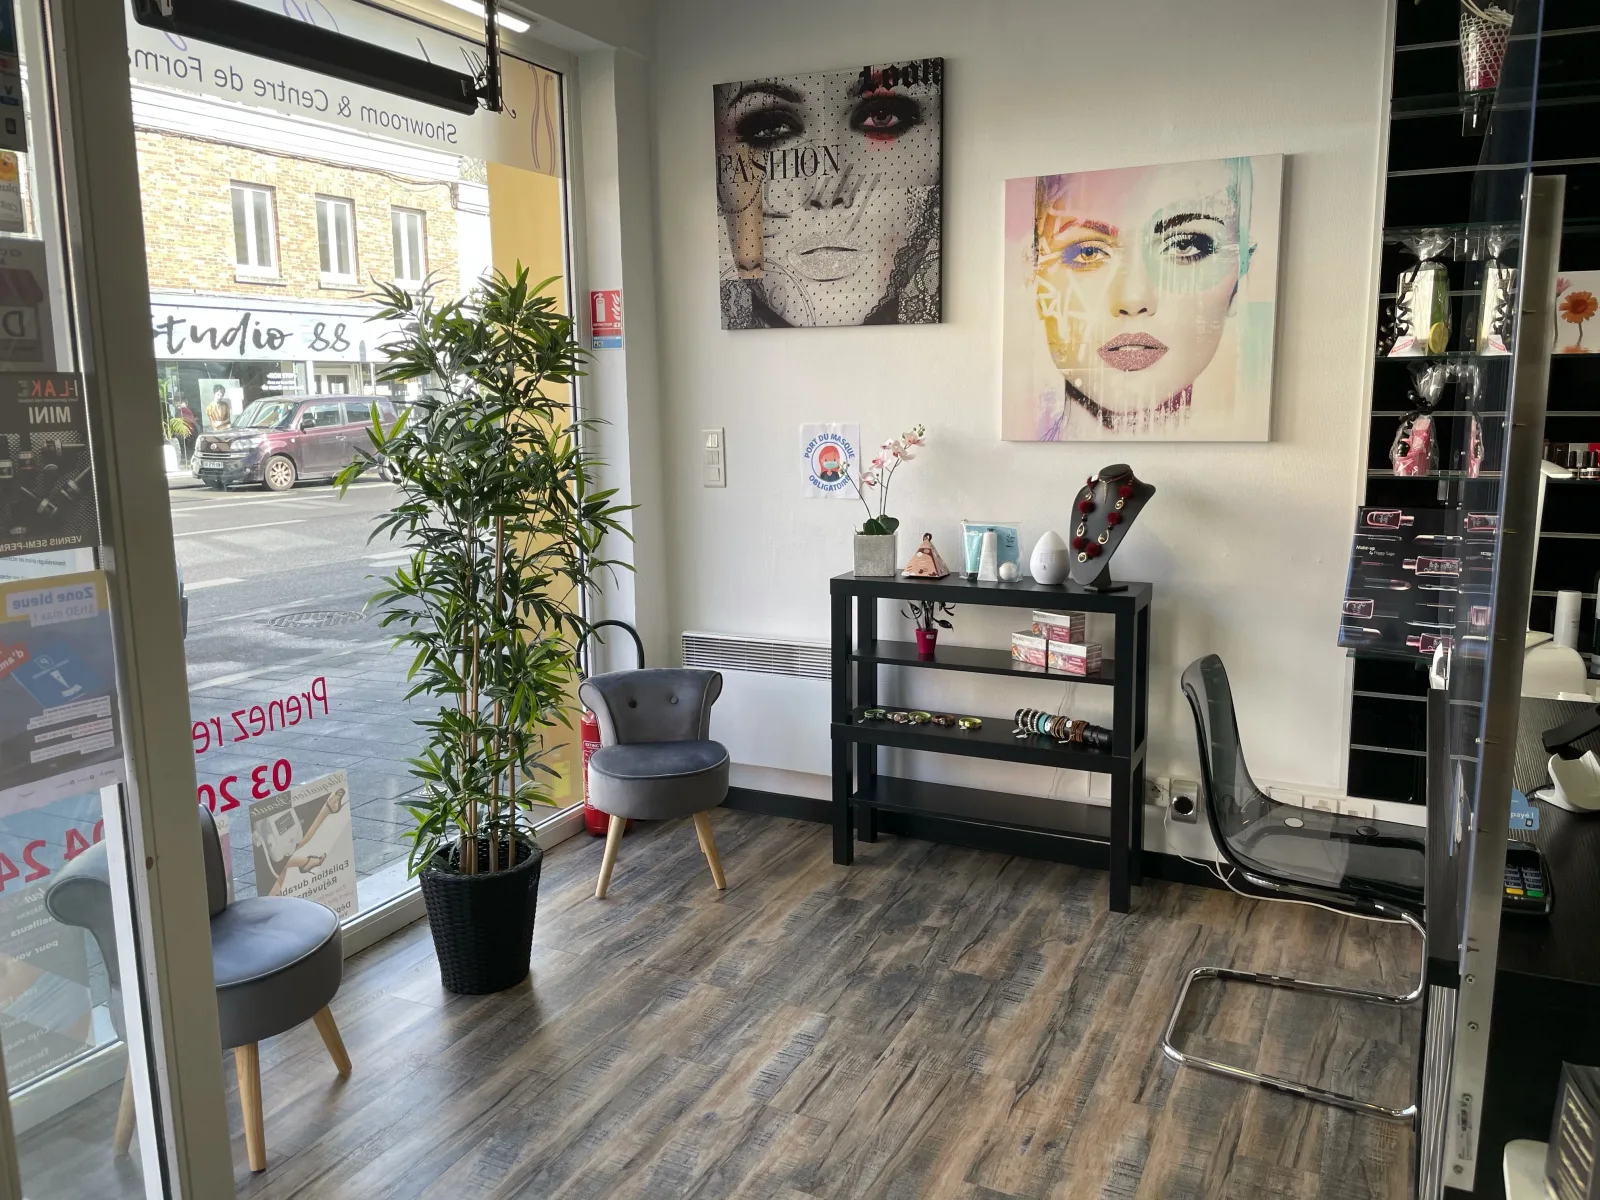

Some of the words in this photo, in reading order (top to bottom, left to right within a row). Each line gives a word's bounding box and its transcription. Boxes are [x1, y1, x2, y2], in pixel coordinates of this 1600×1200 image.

[308, 322, 351, 352] 88
[804, 437, 819, 459] PORT
[818, 433, 829, 442] DU
[830, 433, 856, 459] MASQUE
[1511, 812, 1530, 820] payé
